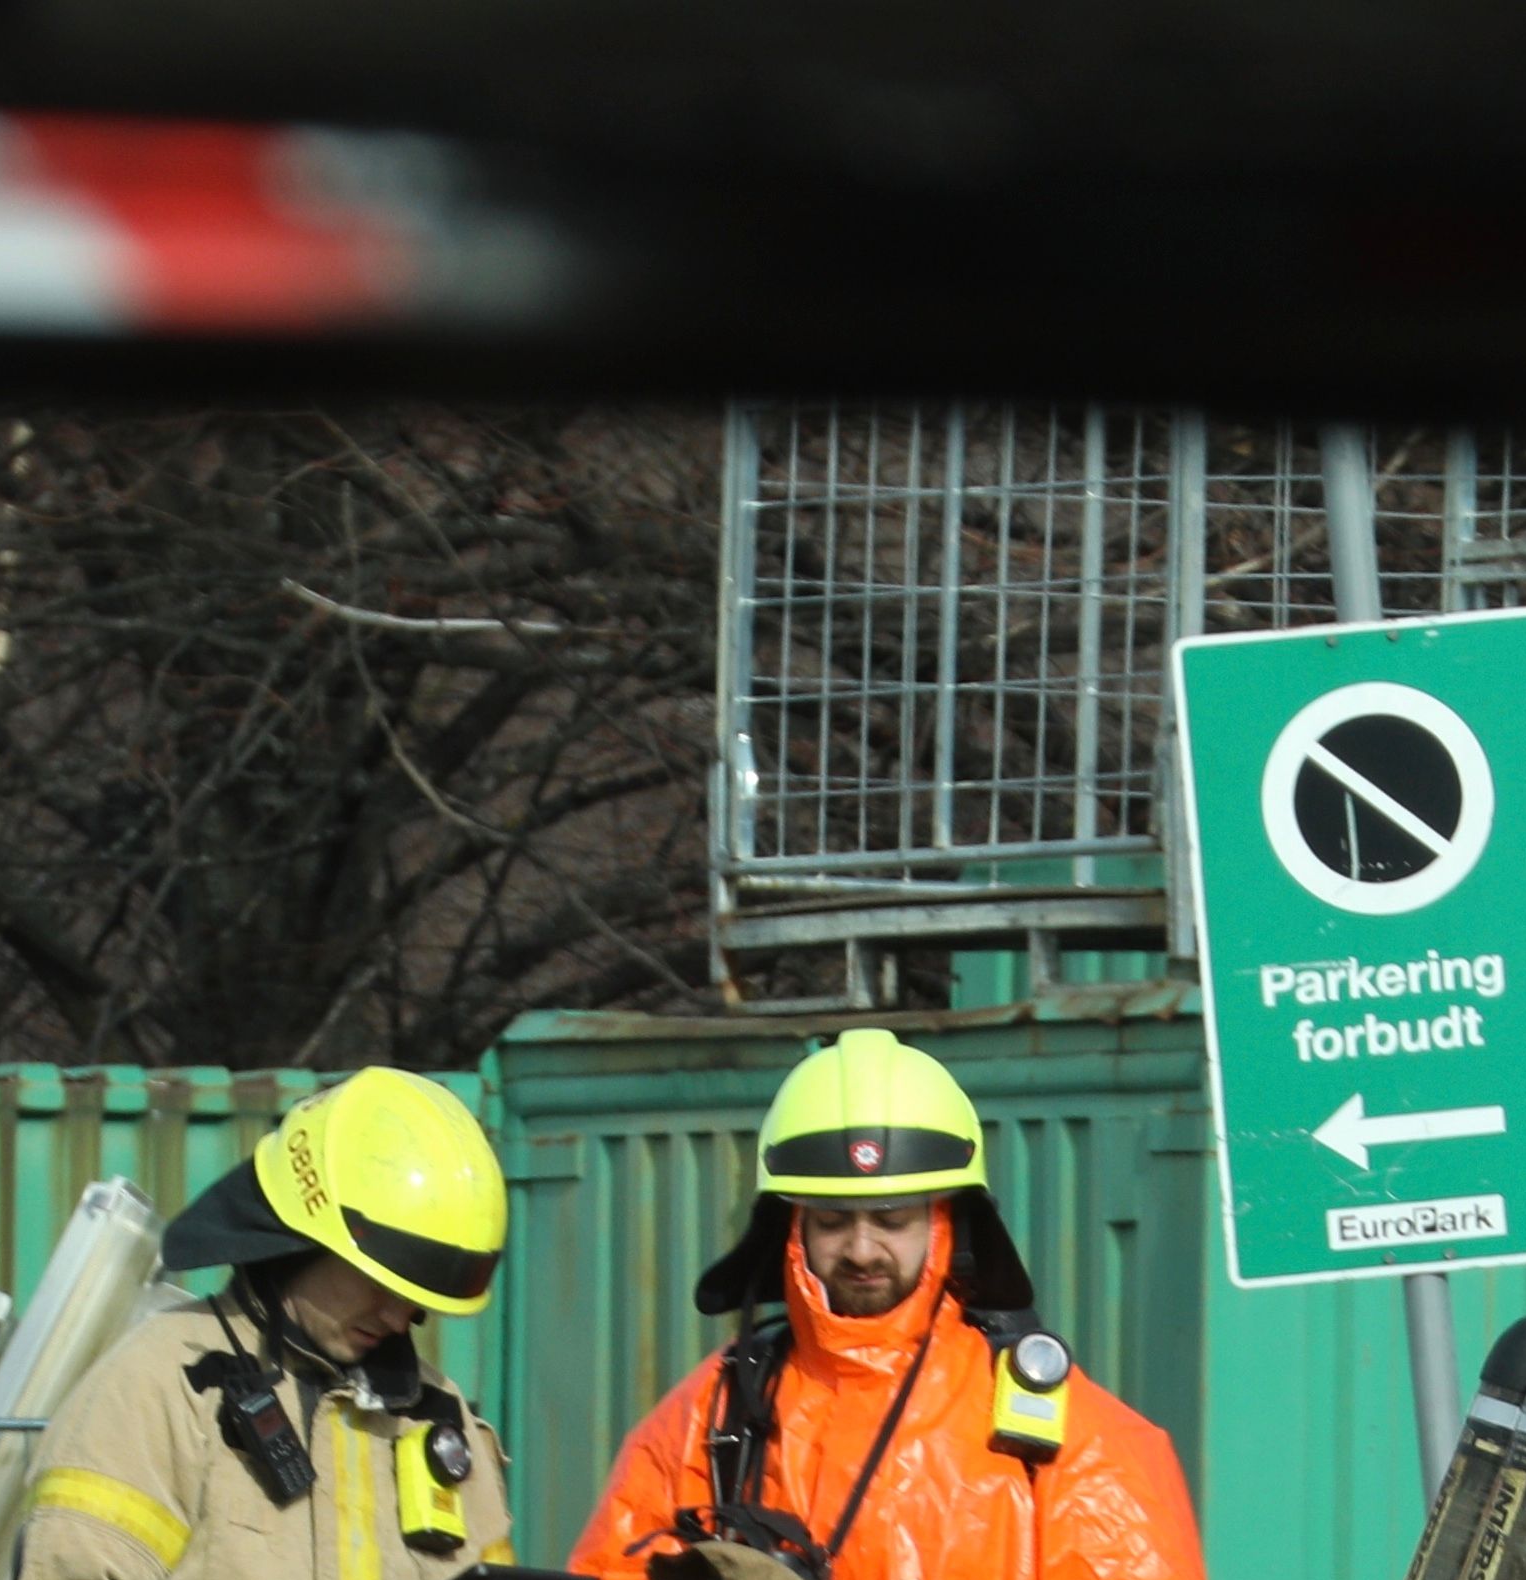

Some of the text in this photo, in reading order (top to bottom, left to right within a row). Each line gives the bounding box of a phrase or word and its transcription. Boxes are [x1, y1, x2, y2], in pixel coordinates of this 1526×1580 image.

[1260, 949, 1505, 1007] Parkering
[1292, 1004, 1486, 1062] forbudt
[287, 1128, 329, 1217] OBRE
[1338, 1203, 1494, 1241] EuroPark
